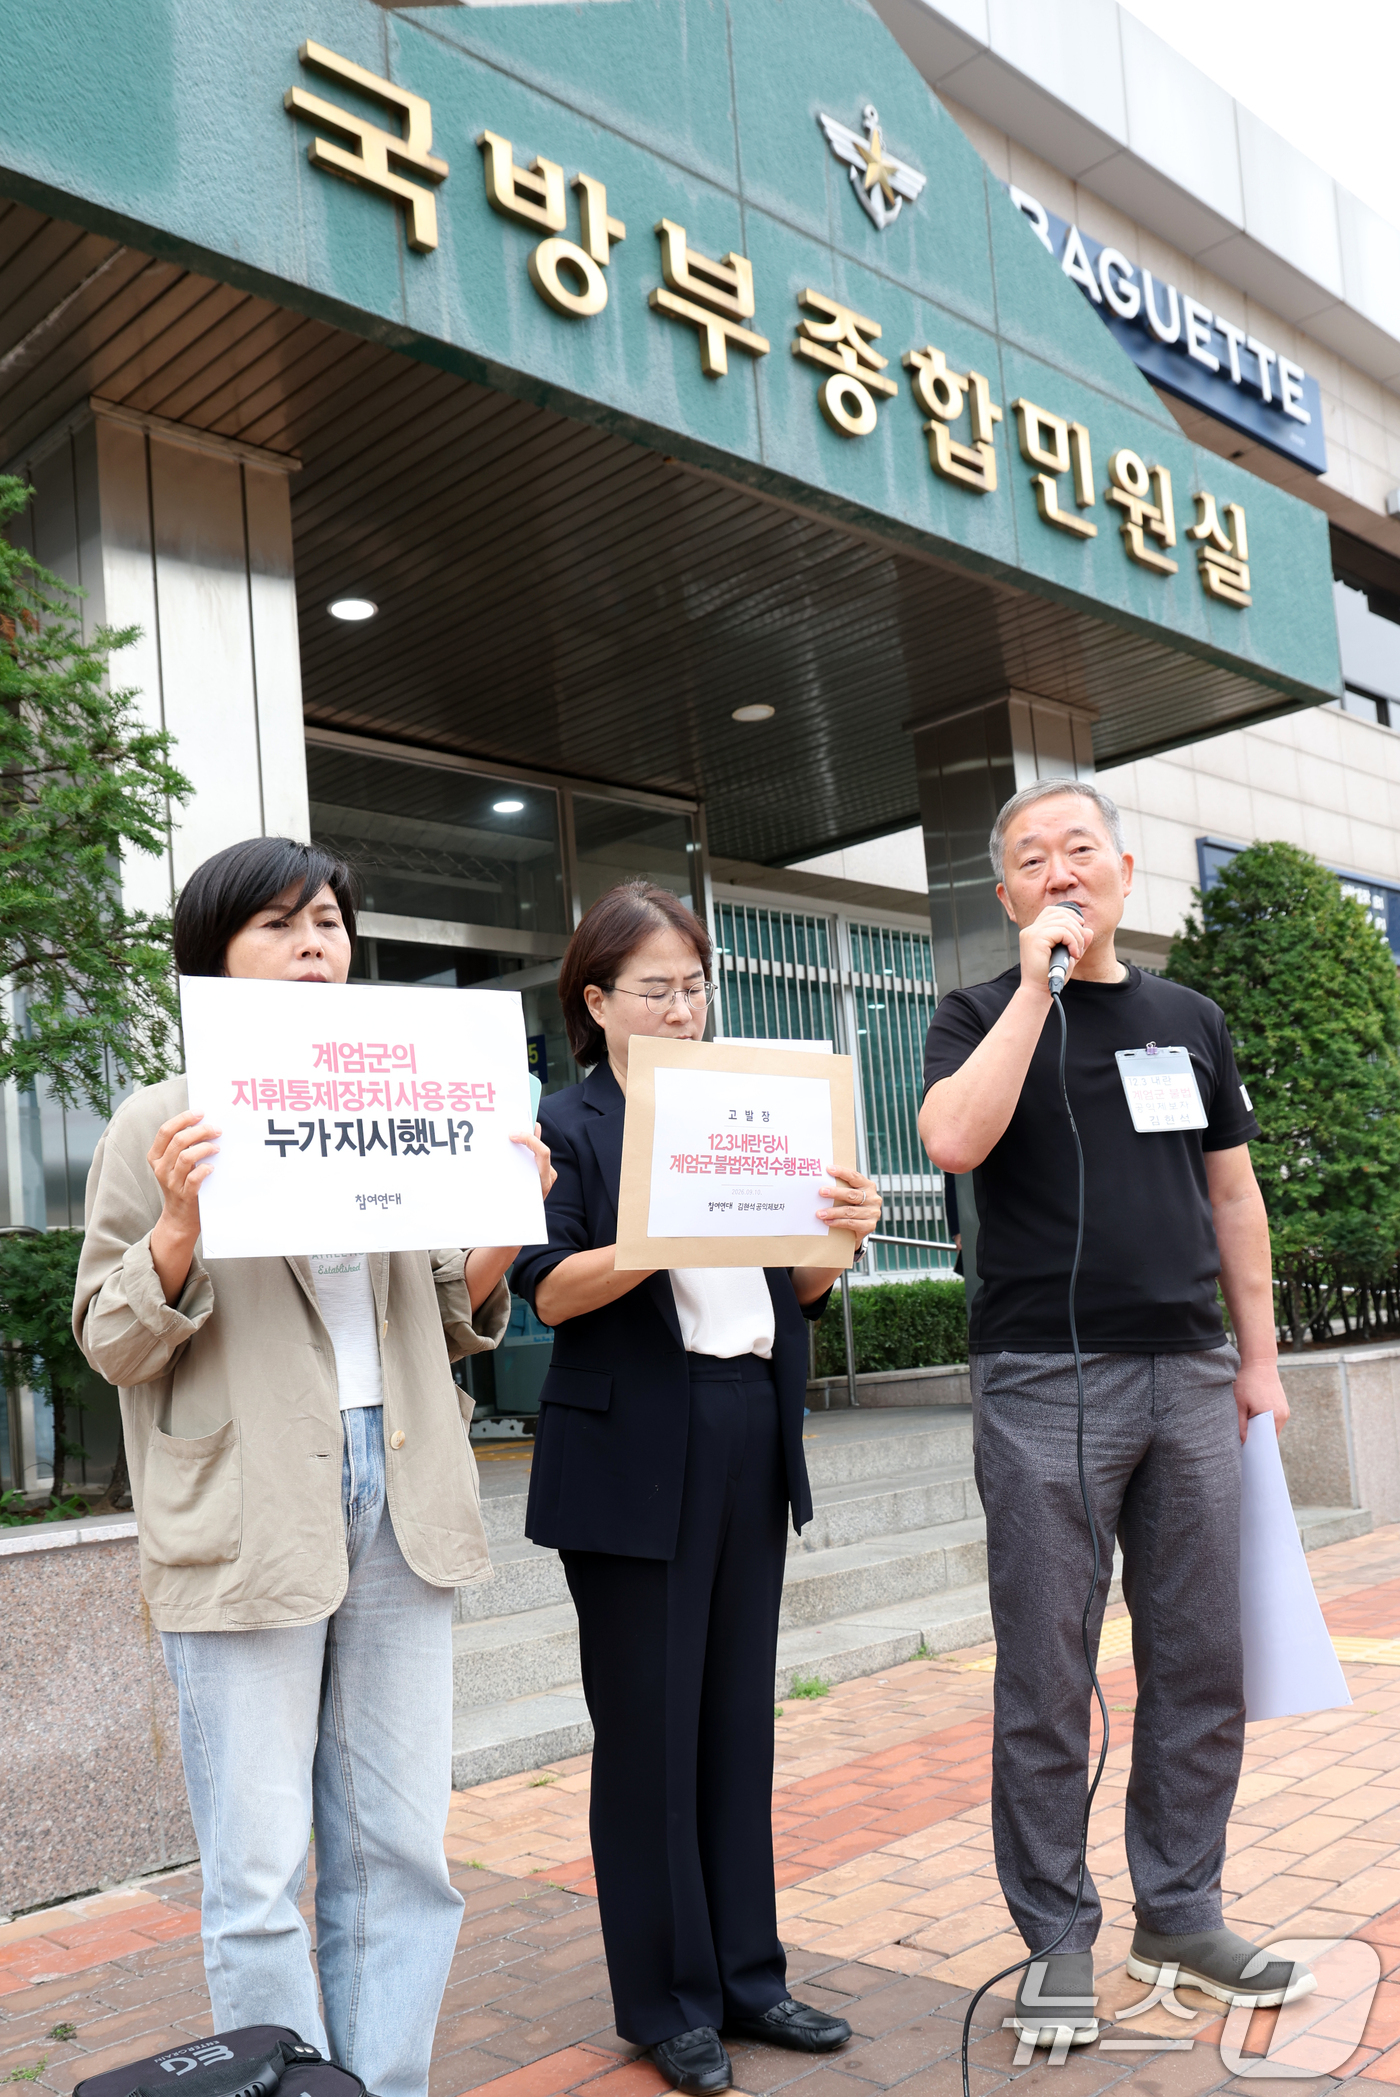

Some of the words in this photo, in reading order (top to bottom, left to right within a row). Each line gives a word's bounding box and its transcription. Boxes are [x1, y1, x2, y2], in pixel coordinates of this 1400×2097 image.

[312, 1041, 417, 1074] 계엄군의
[231, 1078, 392, 1112] 지휘통제장치
[394, 1080, 446, 1112] 사용
[447, 1081, 496, 1112] 중단
[264, 1118, 331, 1157] 누가
[334, 1117, 474, 1157] 지시했나?
[355, 1192, 402, 1210] 참여연대
[708, 1201, 733, 1212] 참여연대
[318, 1262, 361, 1275] Established
[154, 2040, 220, 2064] ENTERGRAIN
